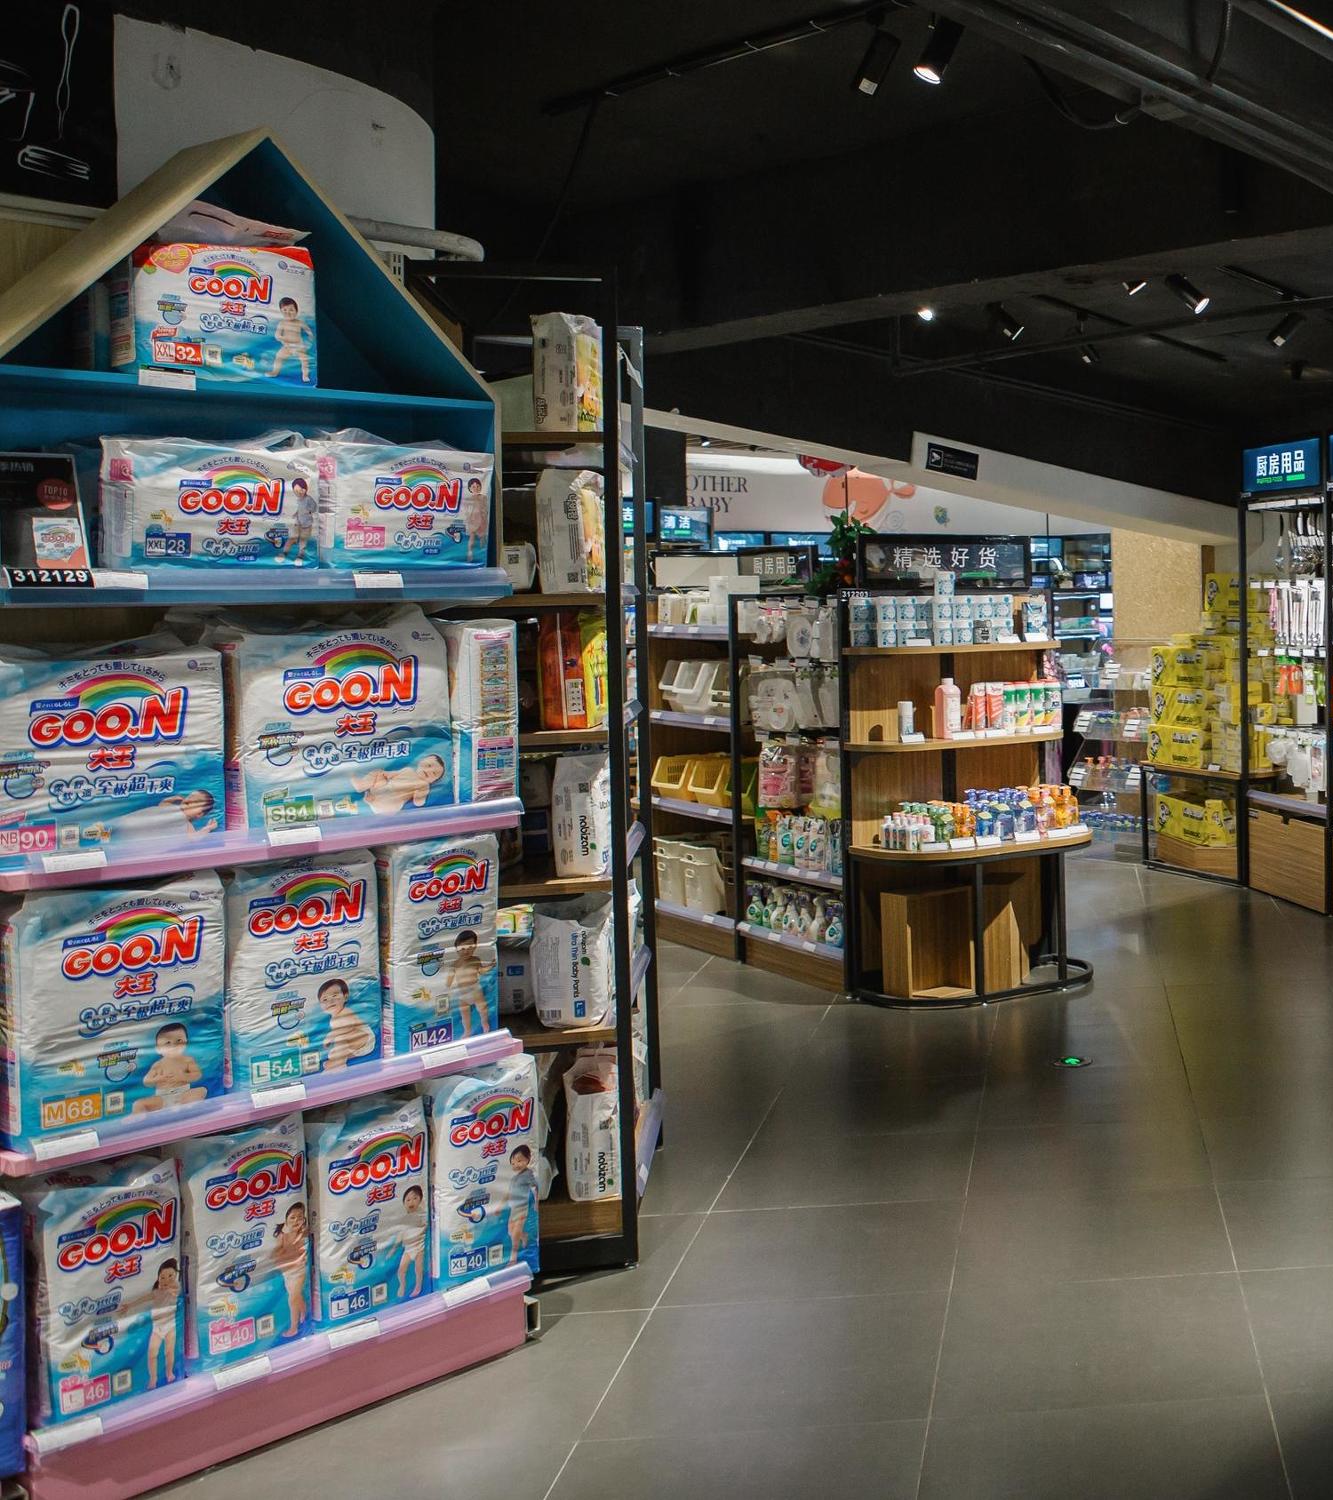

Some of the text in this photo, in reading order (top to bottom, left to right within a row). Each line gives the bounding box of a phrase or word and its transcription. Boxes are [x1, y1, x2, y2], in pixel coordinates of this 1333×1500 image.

[220, 301, 246, 315] 大王
[1256, 450, 1305, 477] 厨房用品
[217, 517, 250, 535] 大王
[407, 513, 434, 530] 大王
[147, 538, 186, 554] XXL 28
[893, 546, 998, 568] 精选好货
[13, 570, 88, 583] 312129
[334, 712, 377, 738] 大王
[87, 746, 137, 771] 大王
[21, 830, 49, 848] 90
[436, 897, 464, 915] 大王
[293, 929, 329, 953] 大王
[113, 971, 158, 998] 大王
[413, 1028, 446, 1047] XL 42
[255, 1060, 294, 1078] L 54
[47, 1099, 95, 1123] M 68
[481, 1138, 507, 1159] 大王
[366, 1181, 397, 1206] 大王
[244, 1198, 276, 1222] 大王
[104, 1254, 142, 1284] 大王
[452, 1254, 483, 1269] XL 40
[336, 1293, 366, 1310] L 46
[232, 1326, 250, 1344] 40
[86, 1383, 105, 1401] 46
